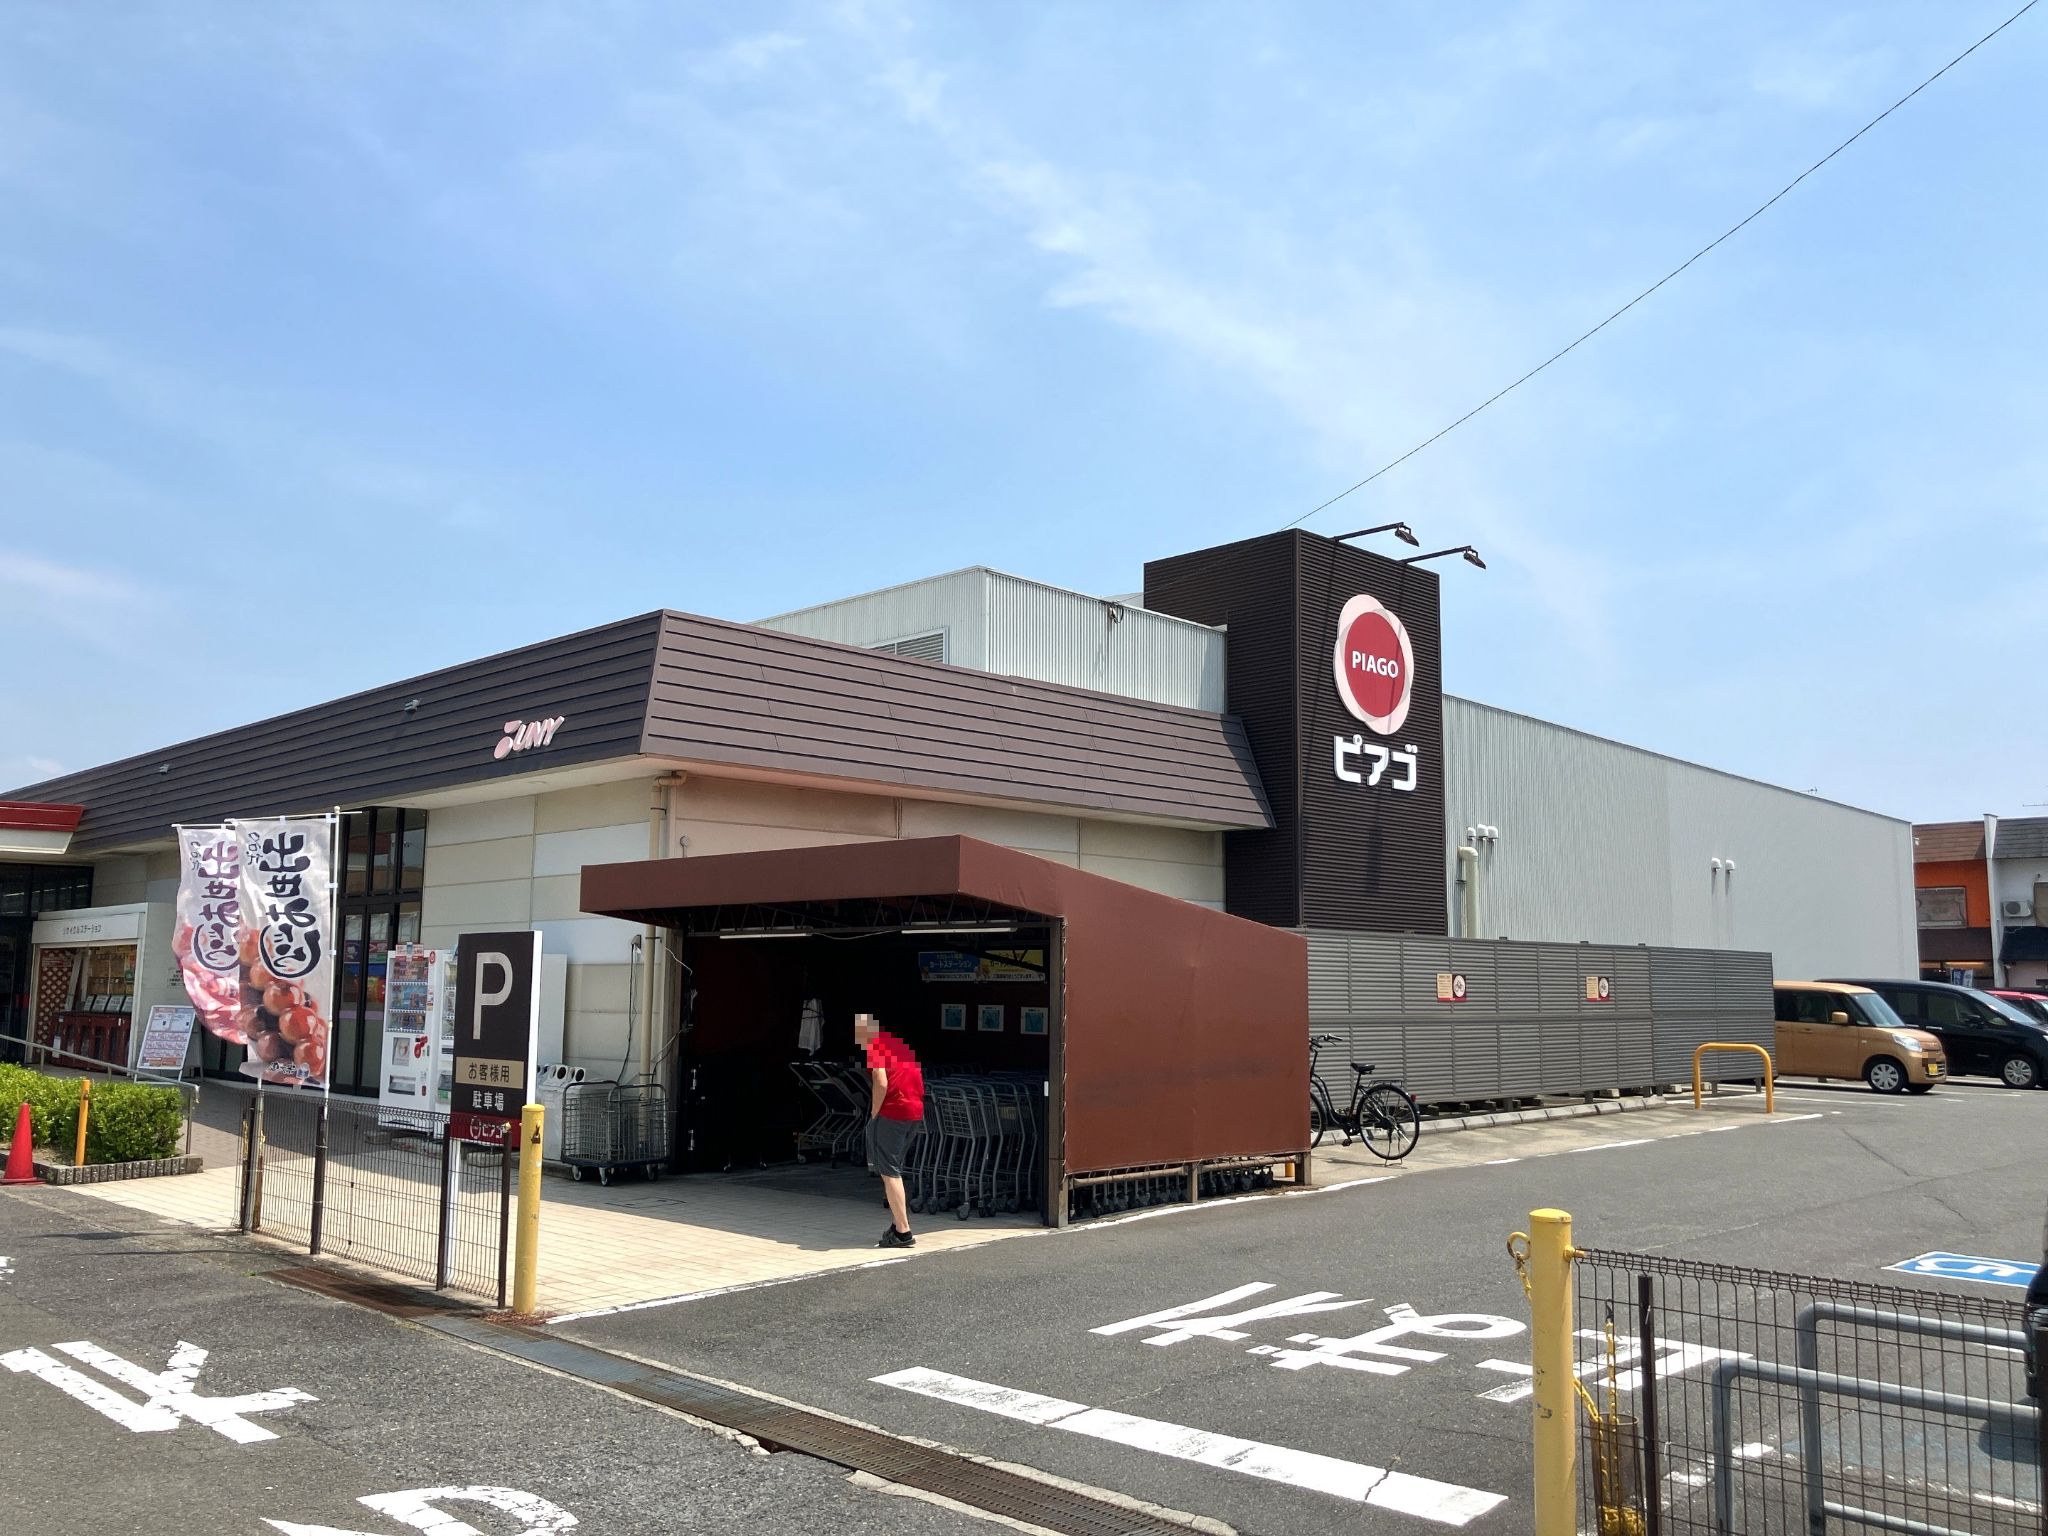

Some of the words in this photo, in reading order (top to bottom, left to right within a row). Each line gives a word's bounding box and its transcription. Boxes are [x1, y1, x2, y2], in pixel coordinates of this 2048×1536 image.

[1351, 650, 1399, 679] PIAGO
[512, 715, 566, 751] UNY
[1333, 733, 1418, 792] ピアゴ
[472, 951, 514, 1040] P
[468, 1062, 511, 1083] お客様用
[472, 1090, 505, 1112] 駐車場
